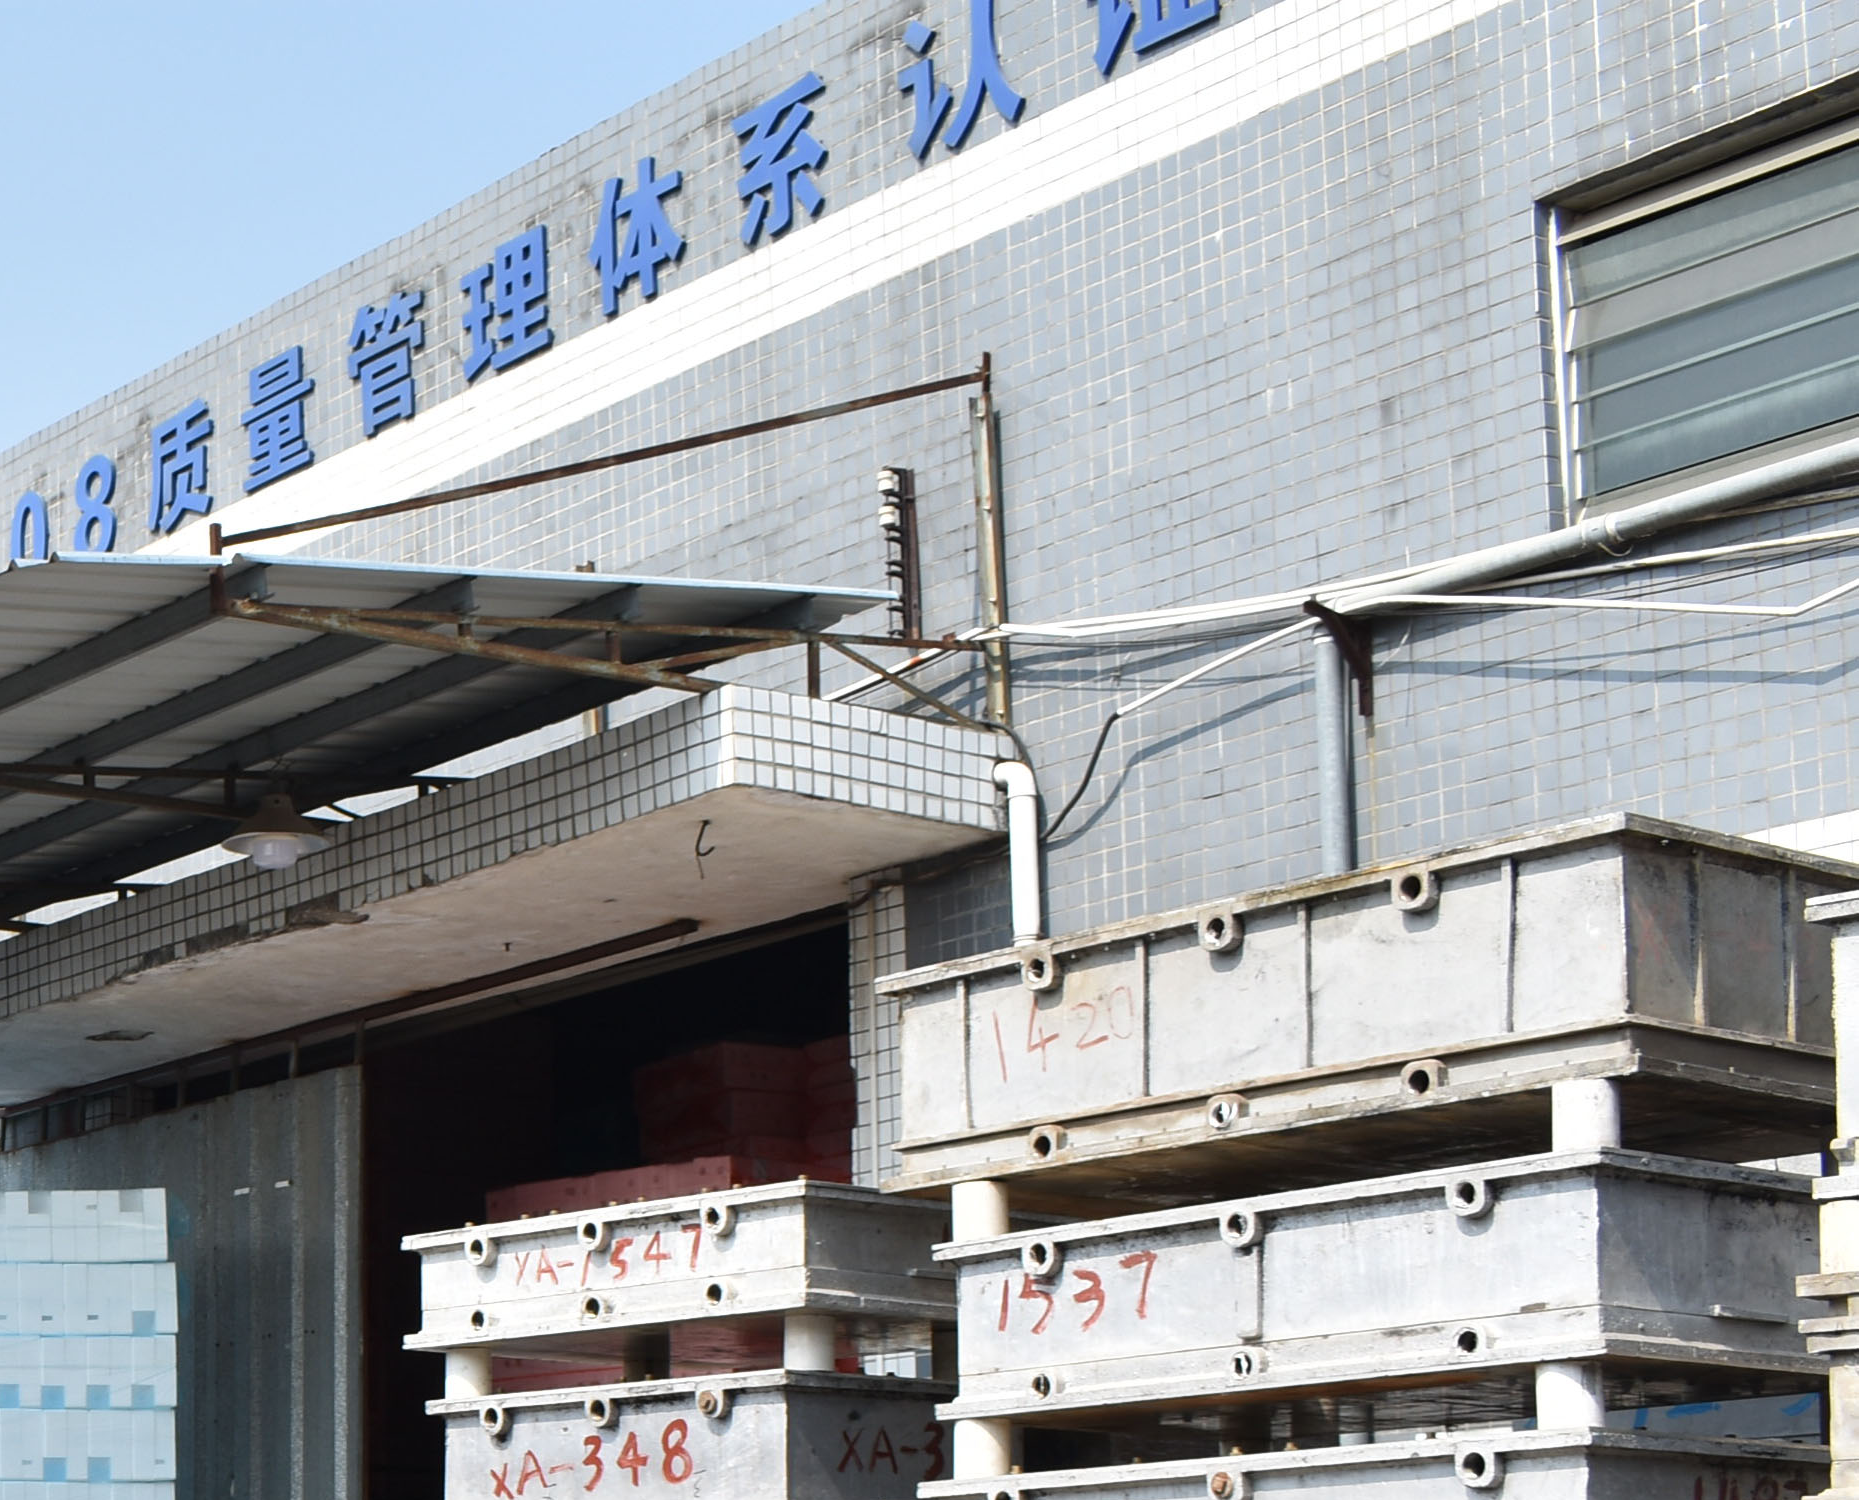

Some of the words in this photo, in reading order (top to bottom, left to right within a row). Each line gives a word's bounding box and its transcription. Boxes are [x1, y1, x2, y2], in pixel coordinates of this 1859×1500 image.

[992, 986, 1134, 1083] 1420
[998, 1250, 1158, 1335] 1537
[490, 1418, 695, 1500] XA-348
